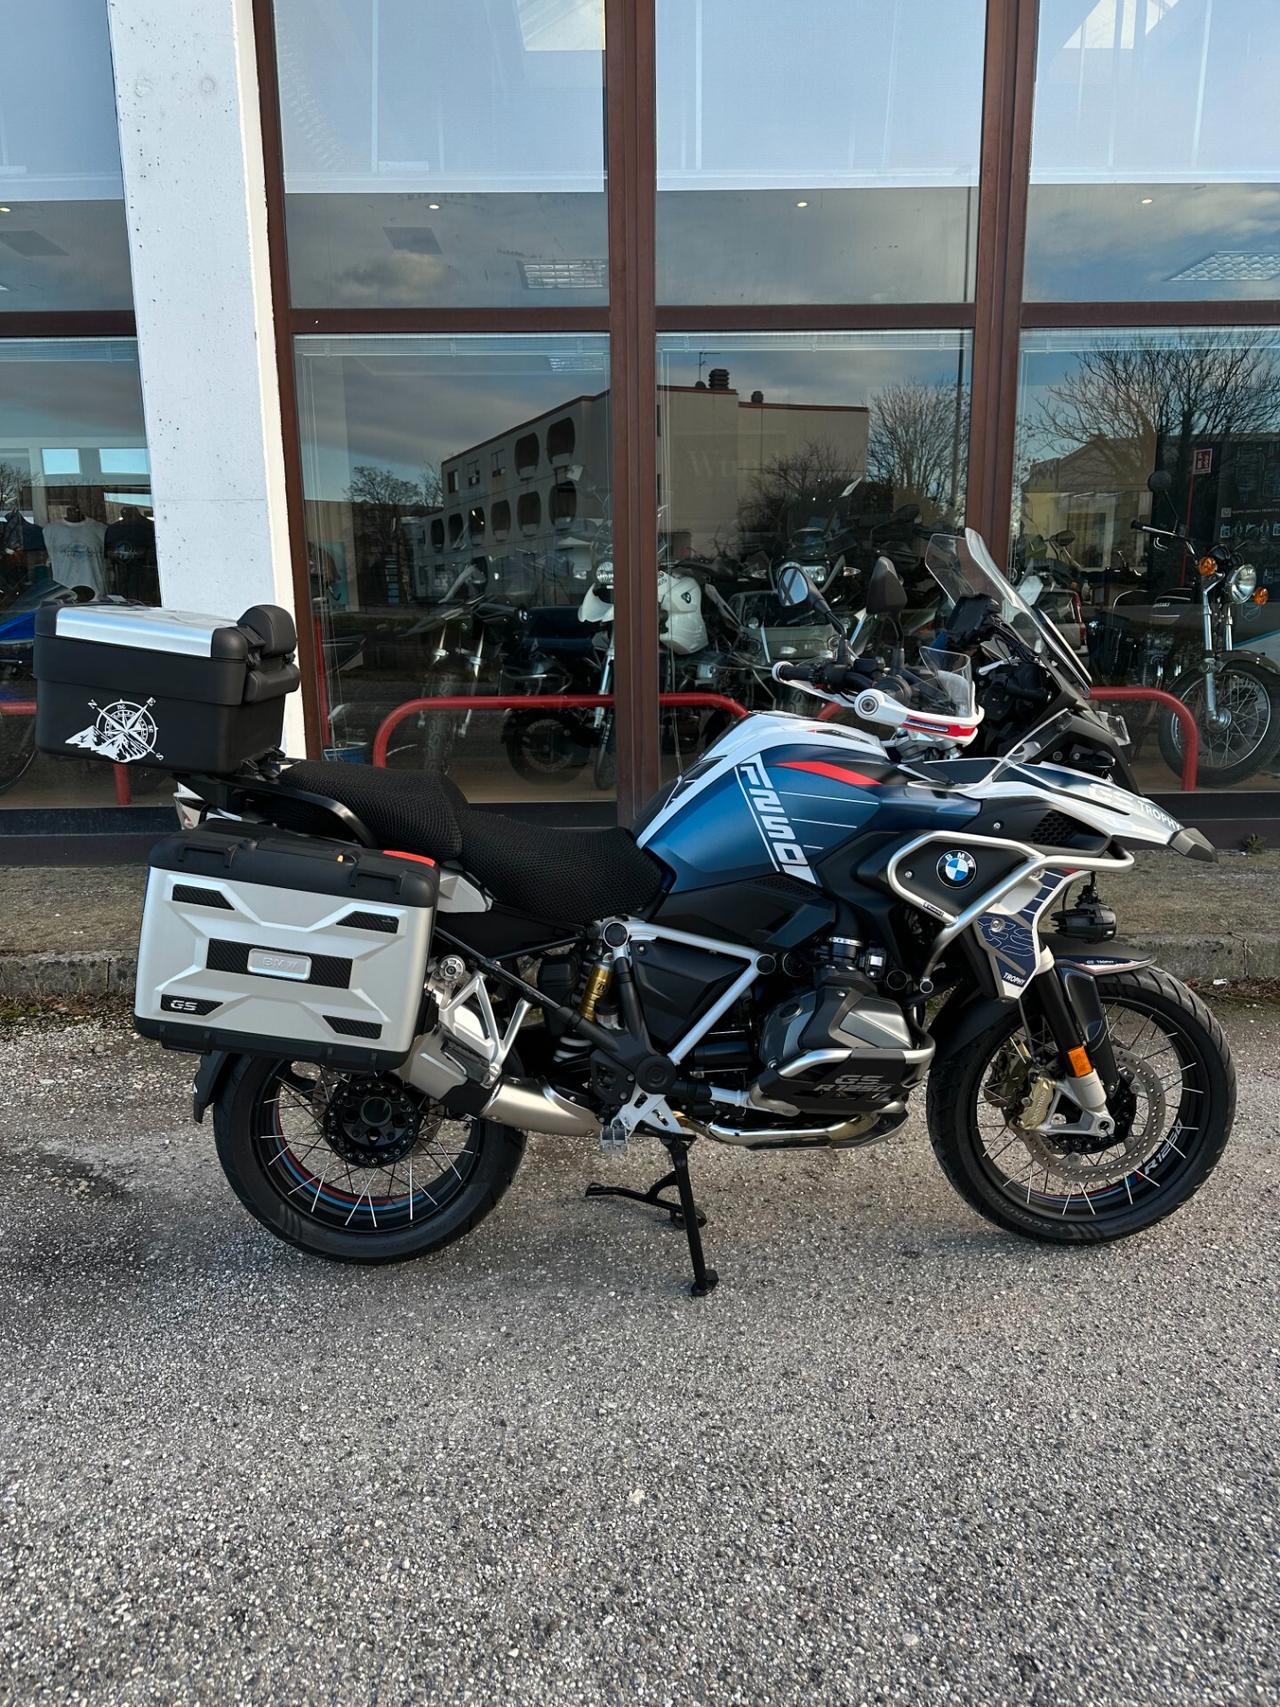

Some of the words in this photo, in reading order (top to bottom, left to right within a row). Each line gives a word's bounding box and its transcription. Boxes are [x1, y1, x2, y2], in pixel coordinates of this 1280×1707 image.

[1137, 799, 1183, 830] TROPHY
[945, 852, 975, 868] BMW
[262, 956, 298, 969] BMW
[1002, 971, 1026, 986] TROPHY
[170, 999, 199, 1012] GS
[834, 1074, 885, 1085] GS
